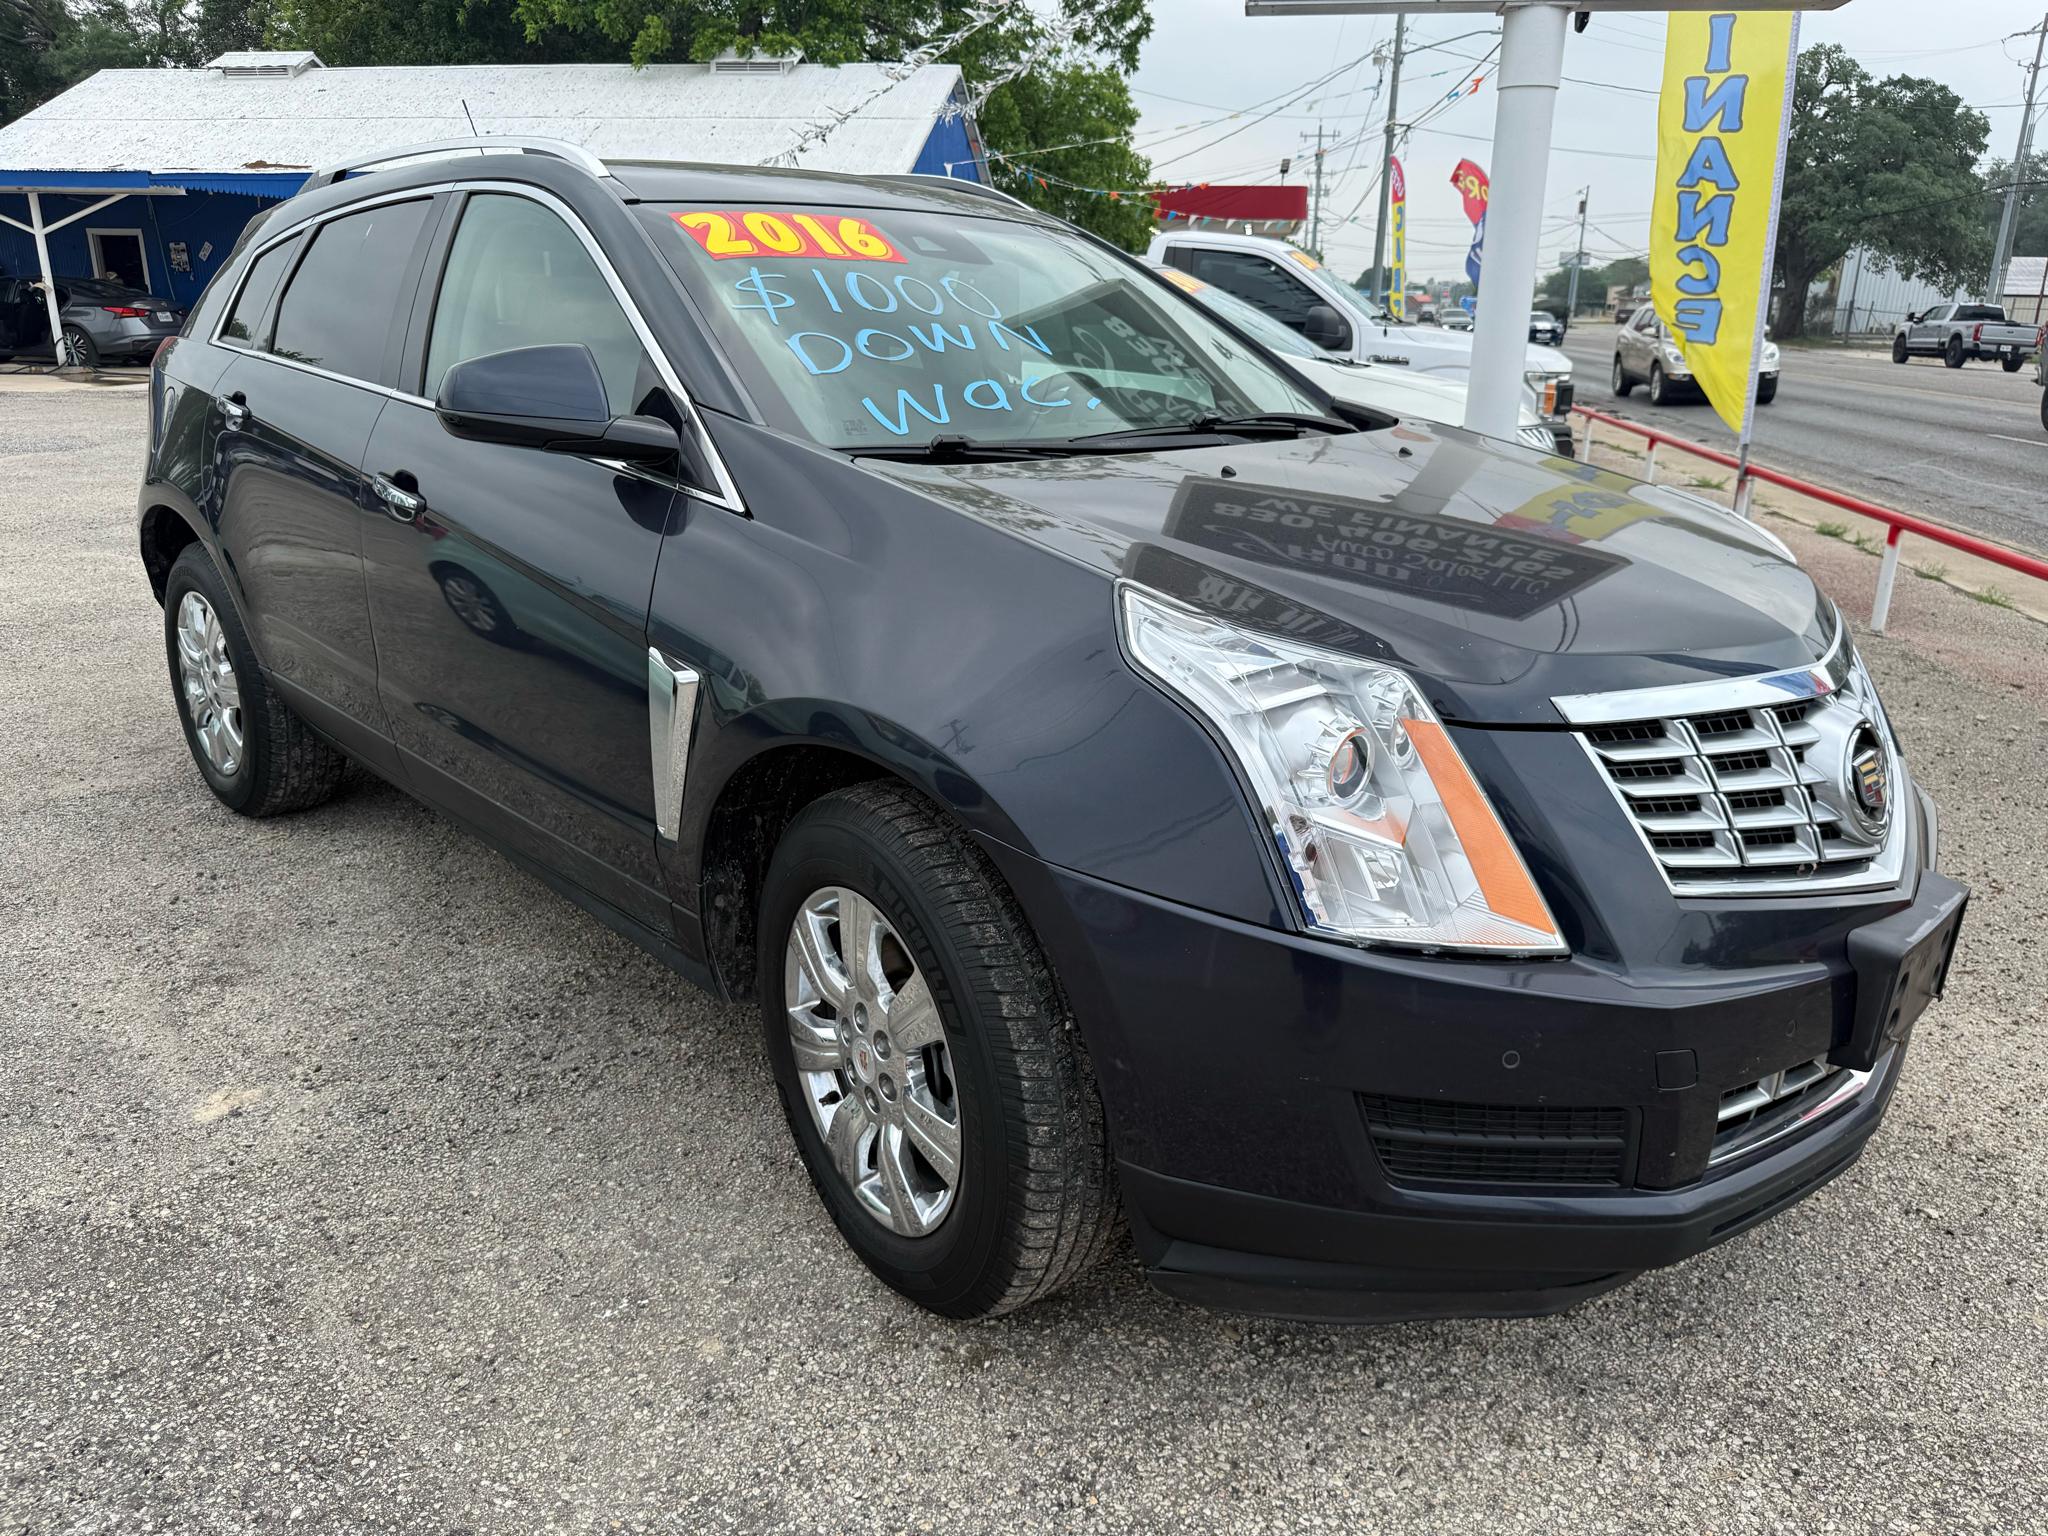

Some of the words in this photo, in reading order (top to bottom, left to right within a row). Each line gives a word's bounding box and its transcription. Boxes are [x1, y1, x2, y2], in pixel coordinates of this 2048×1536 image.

[679, 212, 893, 258] 2016
[732, 266, 1001, 325] $1000
[785, 320, 1053, 375] DOWN
